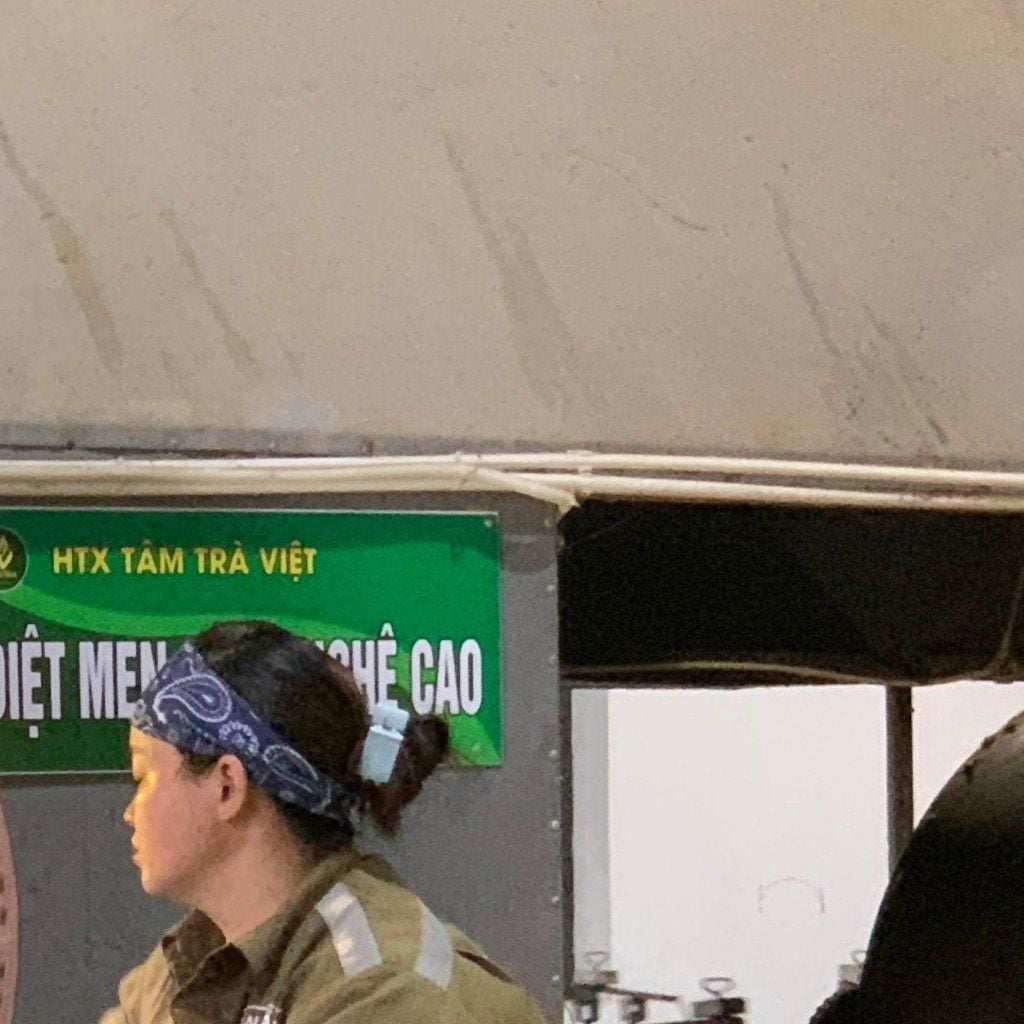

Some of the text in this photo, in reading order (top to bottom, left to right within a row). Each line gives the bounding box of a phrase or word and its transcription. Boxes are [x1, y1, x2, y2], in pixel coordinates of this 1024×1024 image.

[53, 538, 318, 582] HTX TÂM TRÀ VIỆT
[411, 638, 483, 716] CAO
